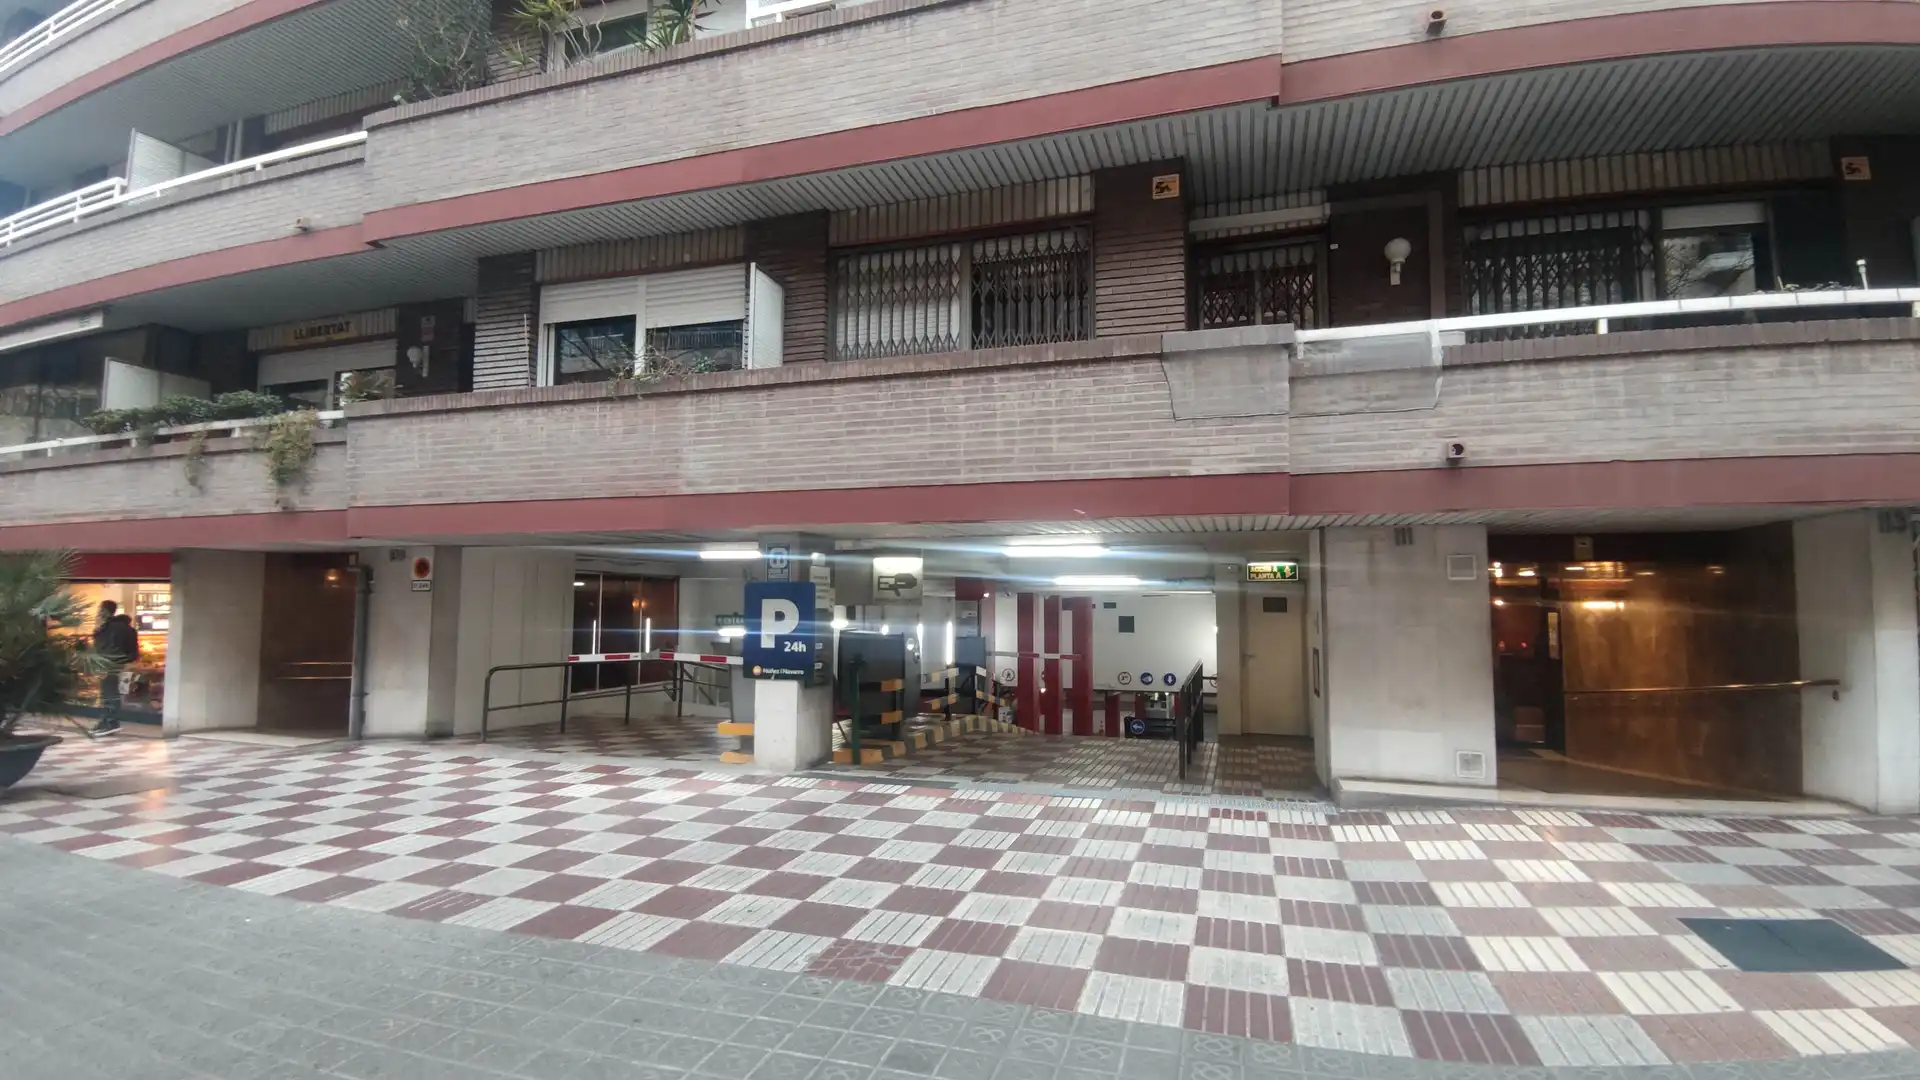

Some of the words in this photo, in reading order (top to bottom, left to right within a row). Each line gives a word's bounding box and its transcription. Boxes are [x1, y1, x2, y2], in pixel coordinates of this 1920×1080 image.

[761, 598, 800, 648] P
[783, 641, 807, 653] 24h
[783, 668, 804, 676] Navarro
